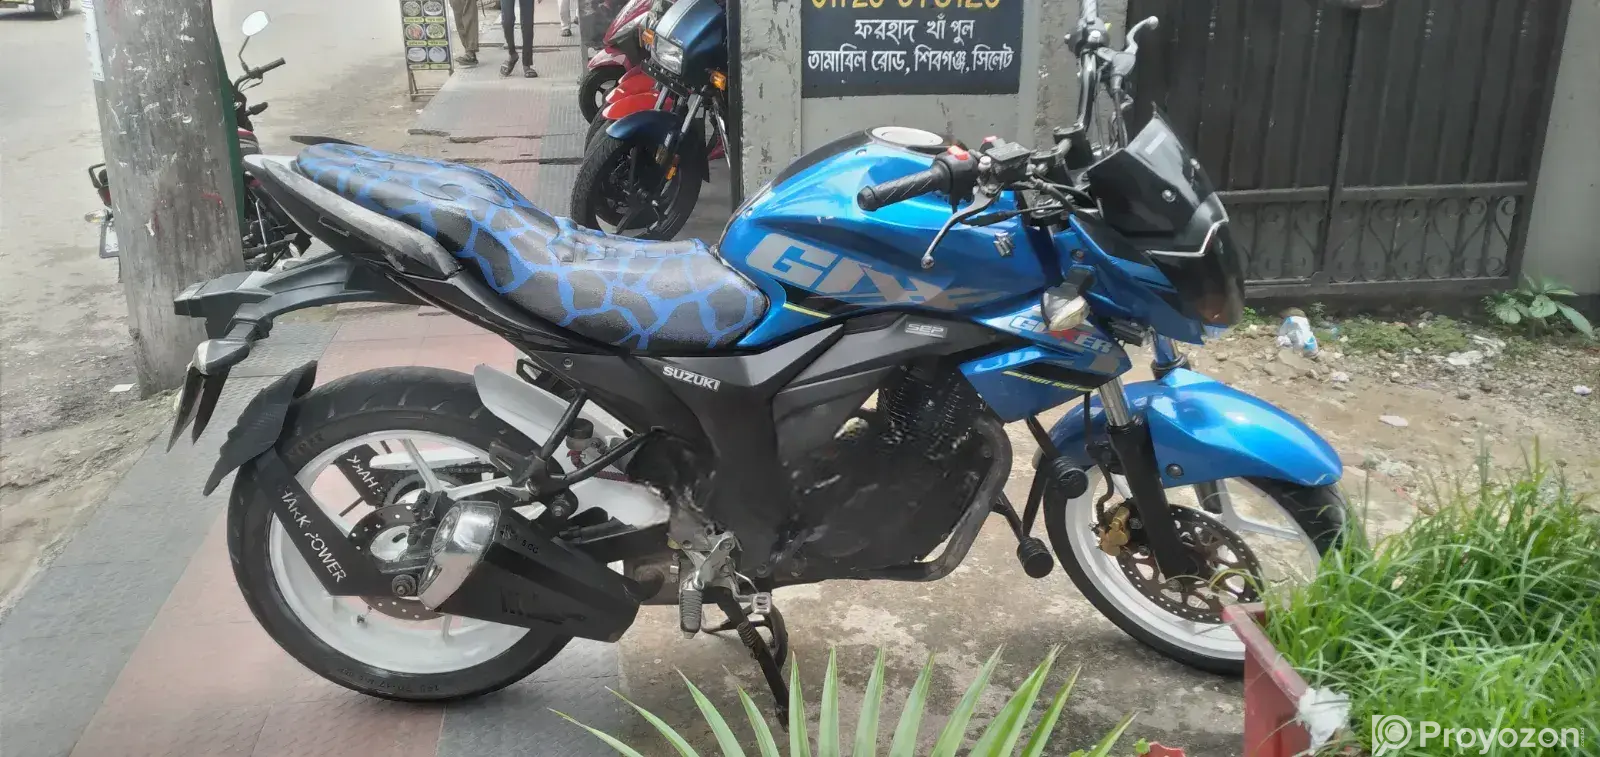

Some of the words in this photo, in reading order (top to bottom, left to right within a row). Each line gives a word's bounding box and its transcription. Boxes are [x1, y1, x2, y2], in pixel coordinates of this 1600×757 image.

[854, 19, 919, 45] ফরহাদ
[926, 12, 946, 39] খাঁ
[950, 20, 976, 46] পুল
[807, 43, 867, 73] তামাবিল
[871, 49, 910, 76] রোড,
[971, 43, 1015, 71] সিলেট
[906, 323, 944, 336] SEP
[662, 366, 720, 391] SUZUKI
